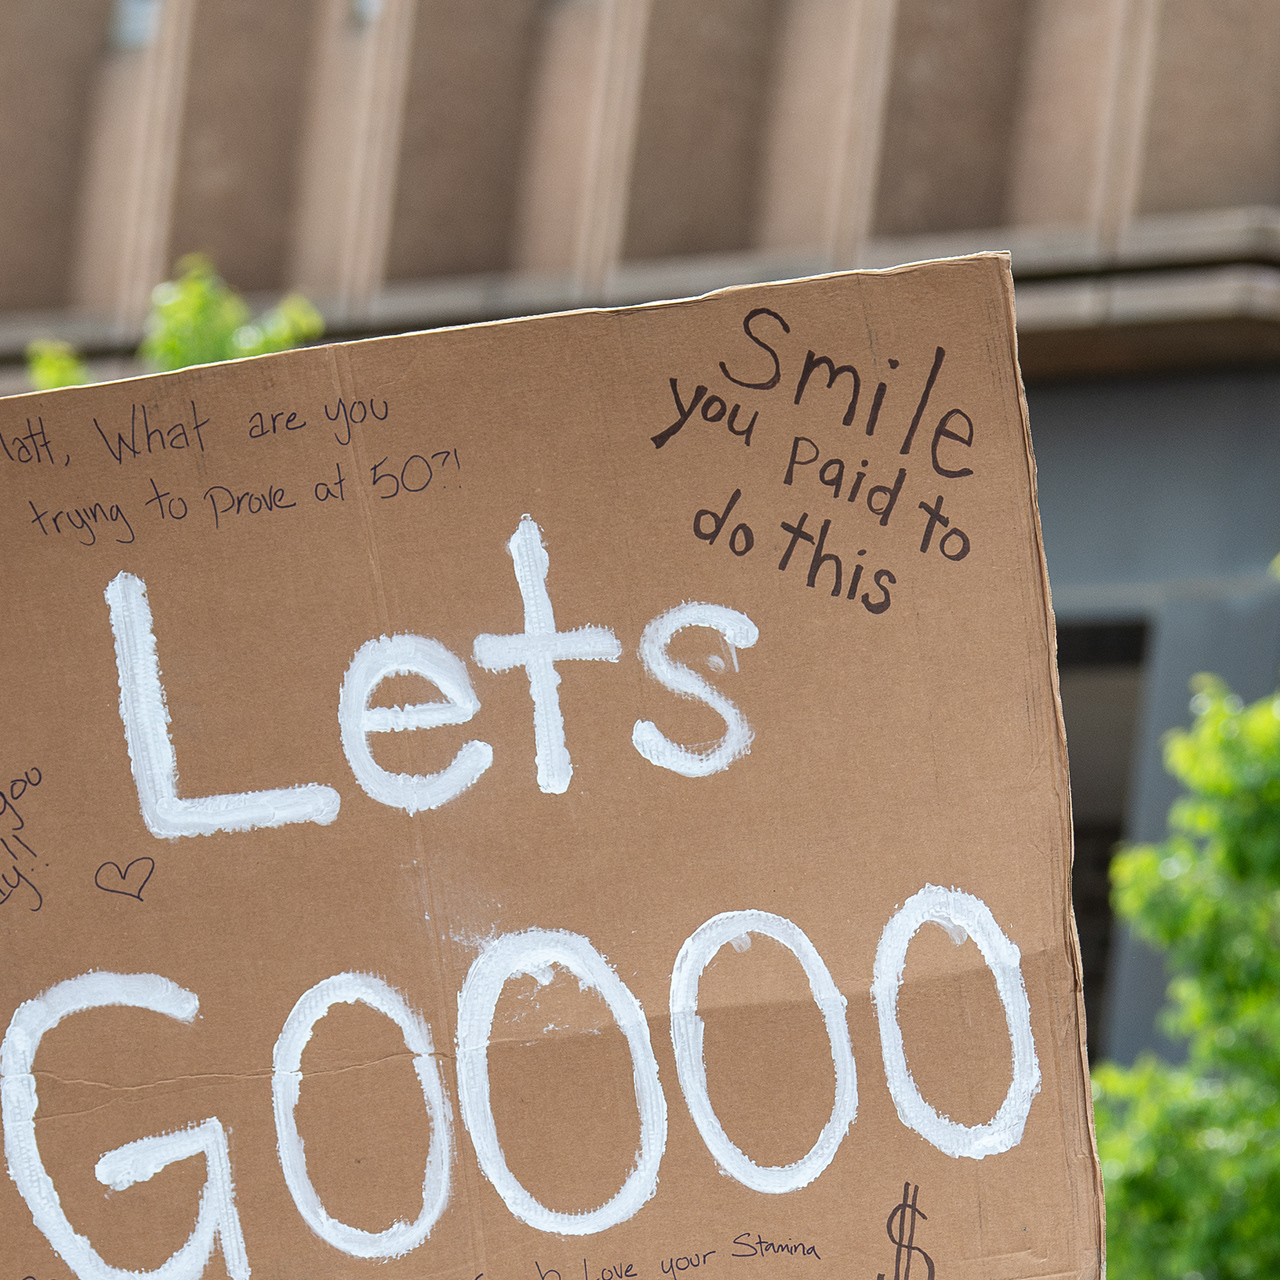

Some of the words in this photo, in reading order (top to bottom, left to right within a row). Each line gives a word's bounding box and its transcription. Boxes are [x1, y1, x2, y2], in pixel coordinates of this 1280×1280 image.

[92, 400, 210, 465] What
[248, 406, 307, 440] are
[323, 395, 389, 446] you
[719, 306, 975, 479] Smile
[30, 497, 135, 547] trying
[144, 479, 189, 522] to
[313, 462, 347, 502] at
[650, 377, 760, 450] you
[919, 494, 971, 562] to
[692, 488, 755, 557] do
[778, 511, 898, 615] this
[104, 512, 760, 840] Lets
[730, 1231, 822, 1262] Stamina
